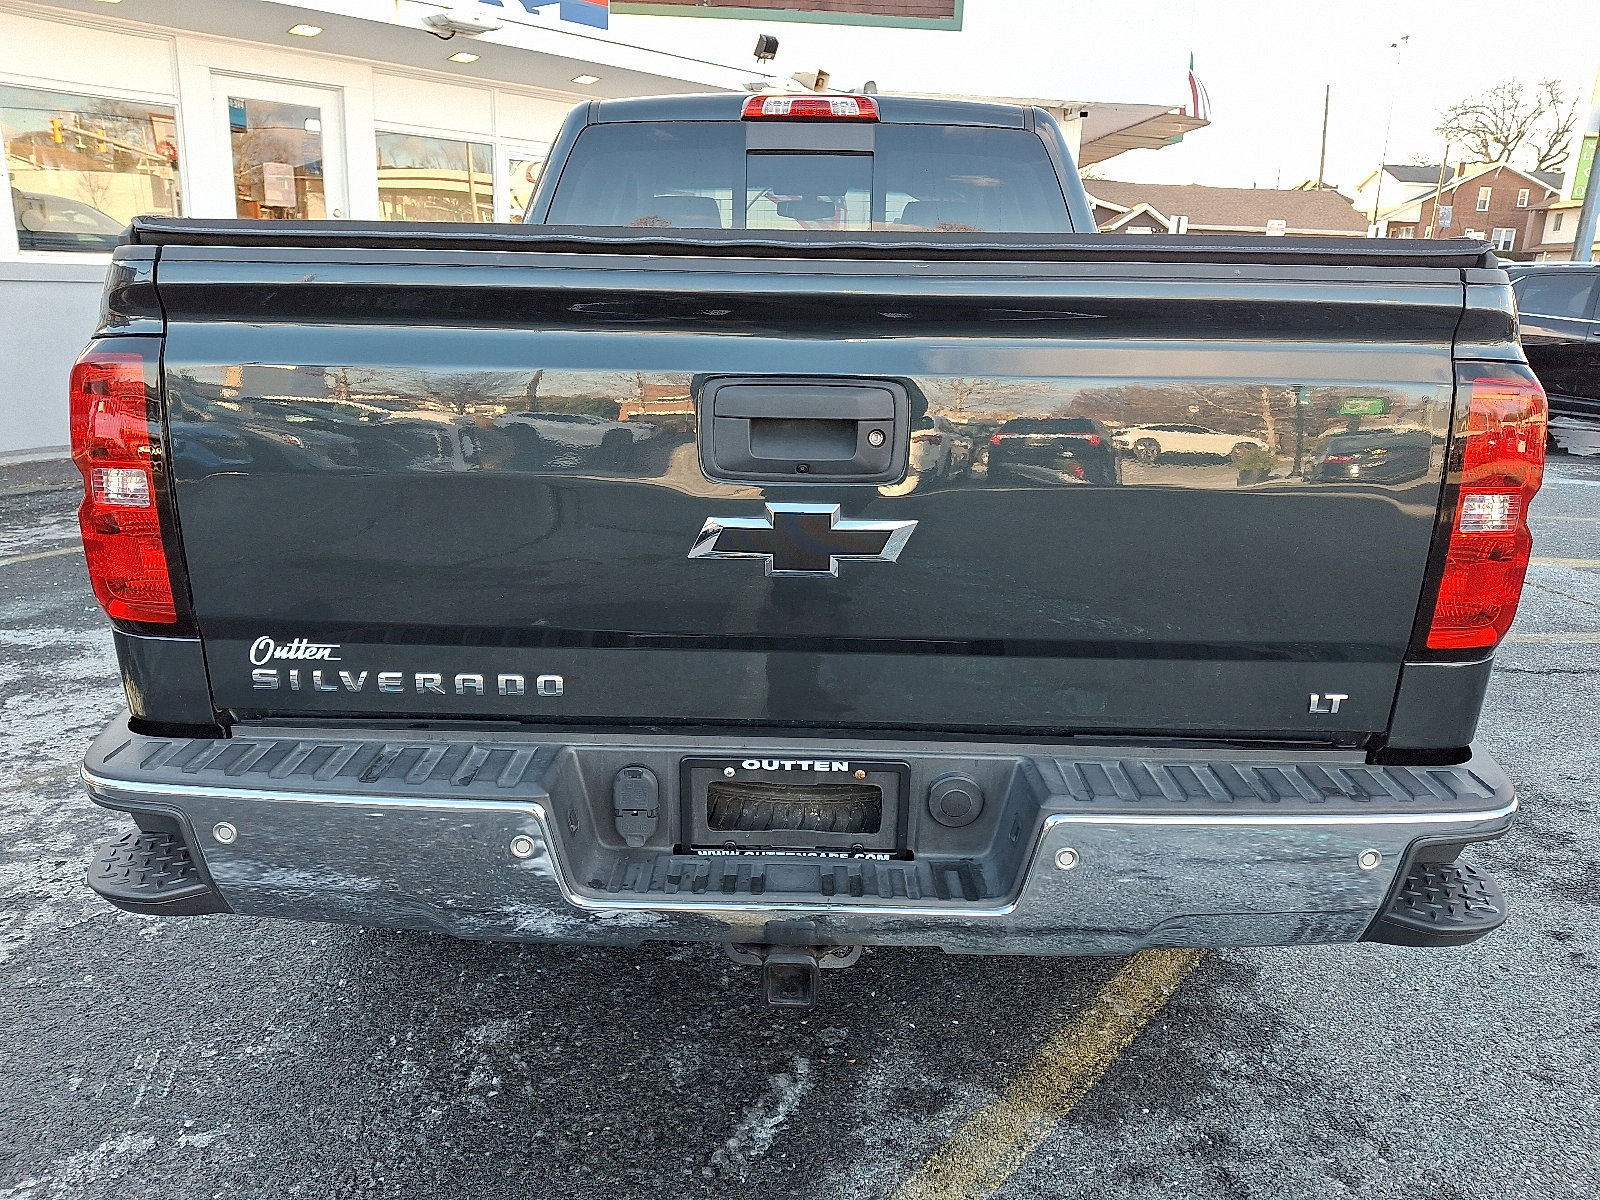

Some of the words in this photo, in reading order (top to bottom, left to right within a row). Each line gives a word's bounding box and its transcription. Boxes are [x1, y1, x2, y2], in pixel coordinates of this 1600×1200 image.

[249, 635, 341, 665] Outten
[251, 668, 565, 697] SILVERADO
[1308, 692, 1349, 714] LT
[741, 759, 849, 772] OUTTEN
